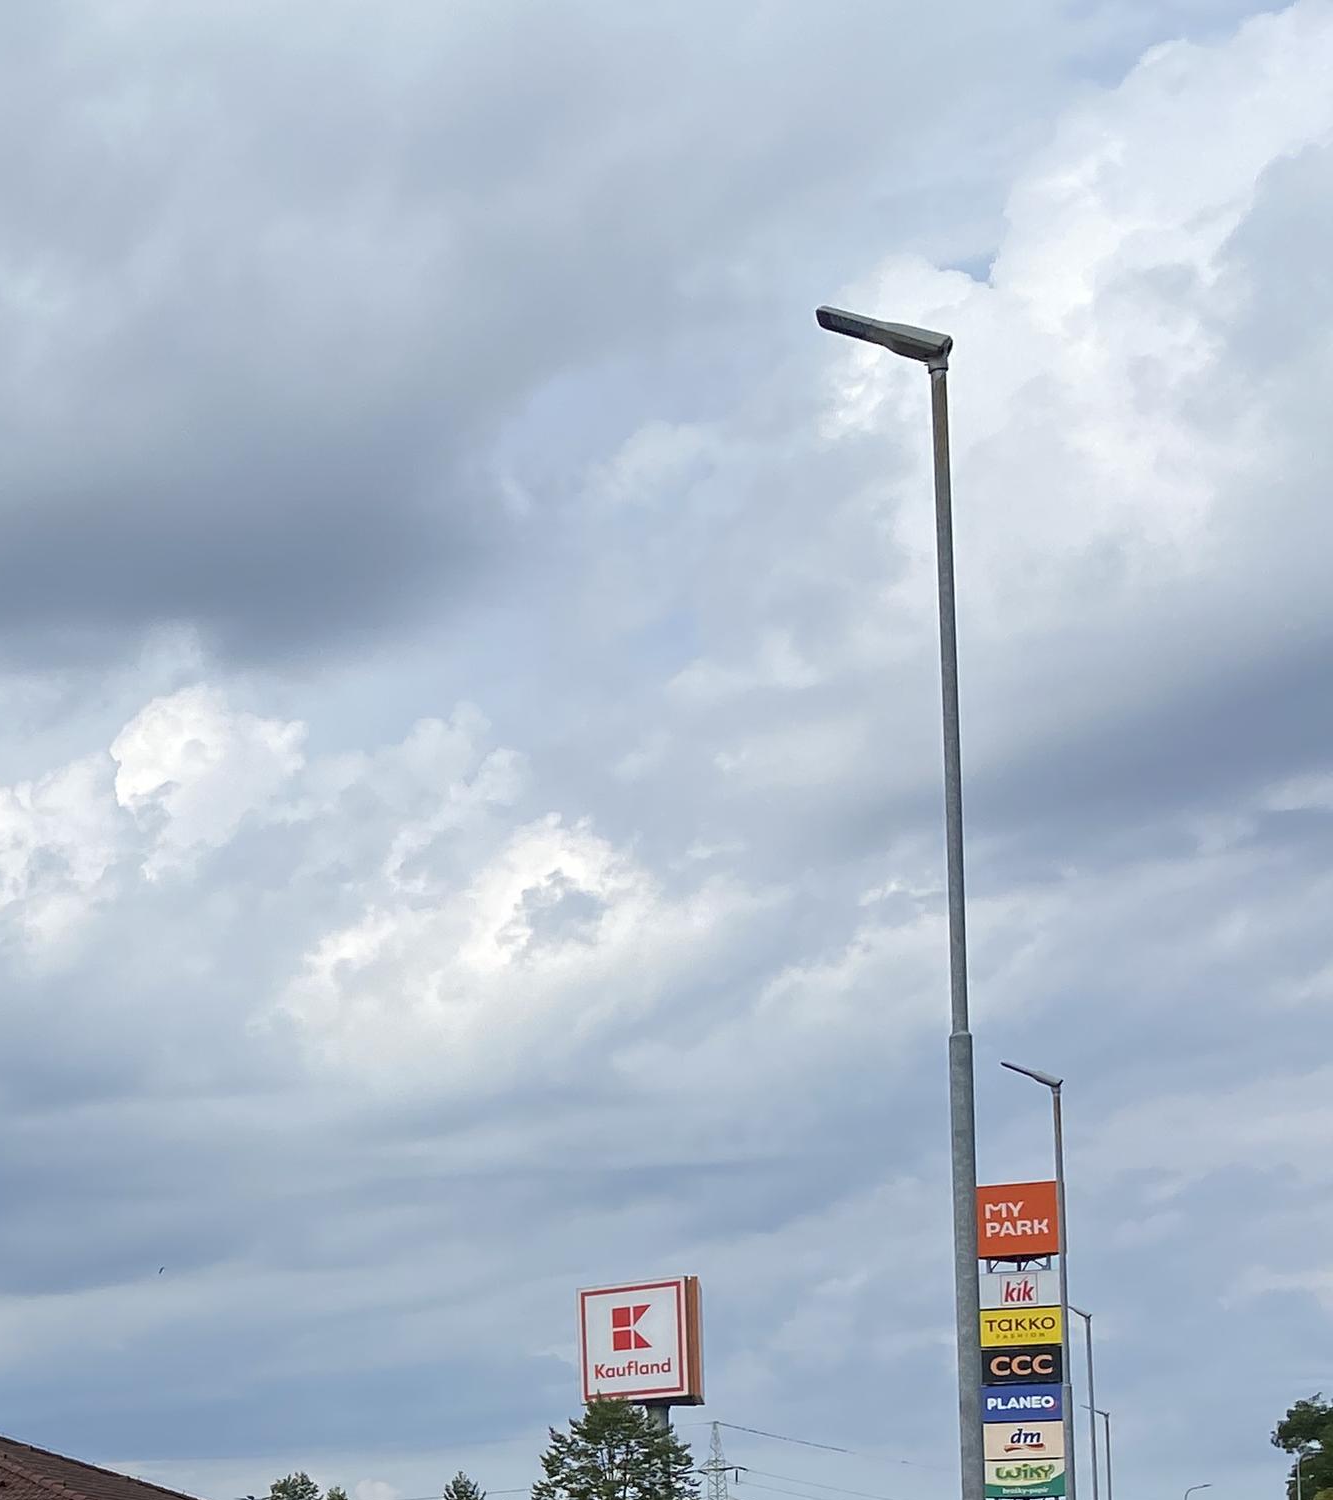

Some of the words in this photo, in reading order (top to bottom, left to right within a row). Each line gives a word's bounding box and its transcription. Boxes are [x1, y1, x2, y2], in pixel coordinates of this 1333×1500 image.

[985, 1201, 1024, 1219] MY
[985, 1219, 1049, 1238] PARK
[1004, 1277, 1034, 1302] kik
[594, 1357, 671, 1379] Kaufland
[989, 1354, 1054, 1376] CCC
[986, 1395, 1055, 1410] PLANEO
[1010, 1428, 1041, 1444] dm
